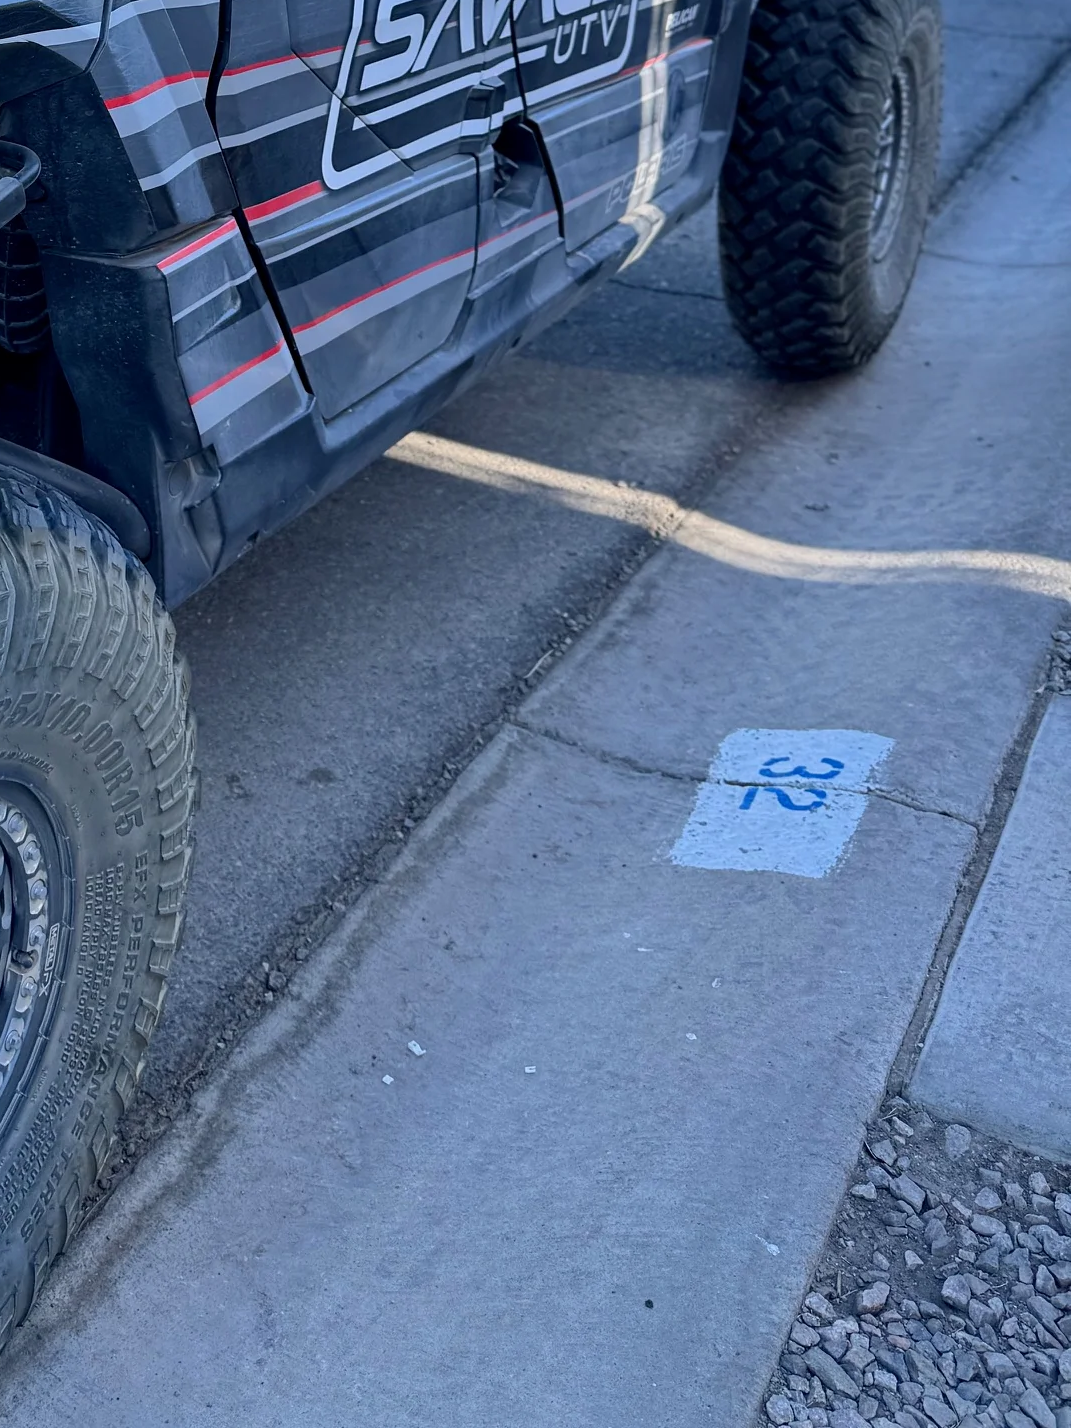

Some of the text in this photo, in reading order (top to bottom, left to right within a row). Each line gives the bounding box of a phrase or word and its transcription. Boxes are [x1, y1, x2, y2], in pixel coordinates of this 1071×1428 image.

[553, 3, 627, 65] UTV
[132, 851, 148, 903] EFX
[69, 915, 144, 1140] PERFORMANCE
[18, 1149, 74, 1244] TIRES
